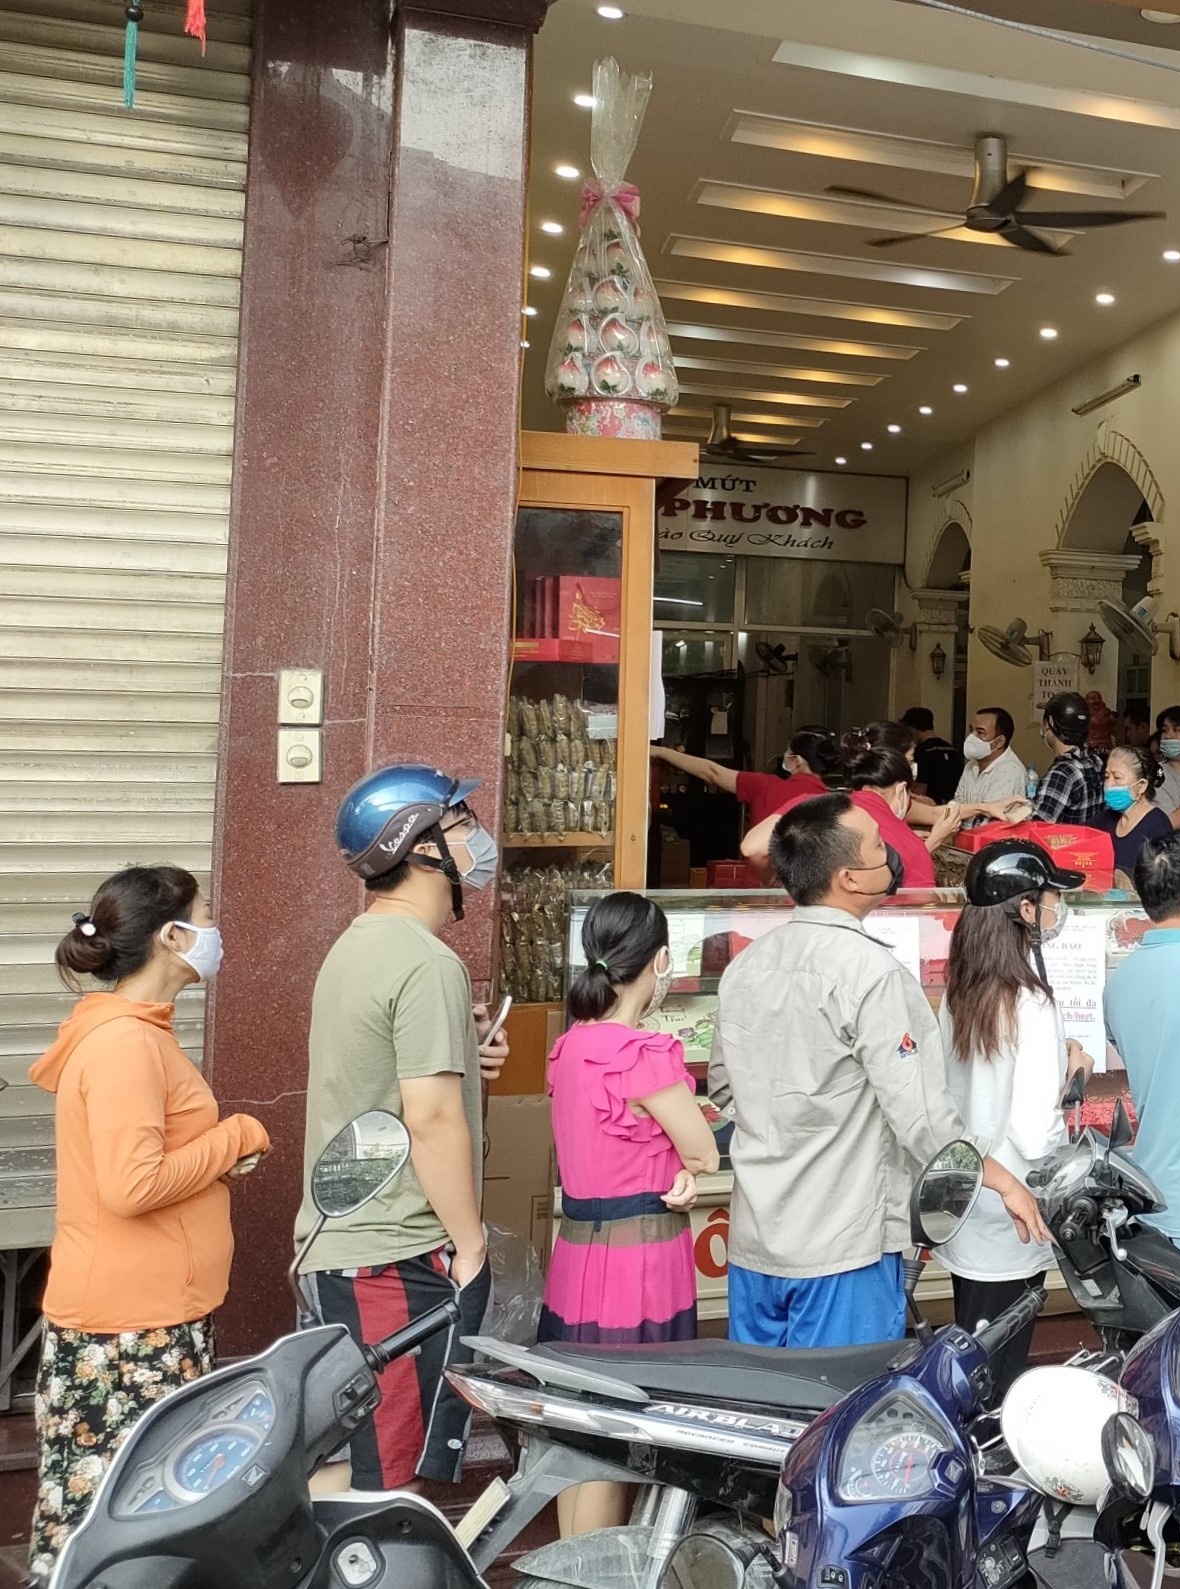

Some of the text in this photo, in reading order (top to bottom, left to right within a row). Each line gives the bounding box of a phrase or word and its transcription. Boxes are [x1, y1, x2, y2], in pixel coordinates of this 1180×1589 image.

[692, 474, 756, 493] MỨT
[661, 498, 867, 529] PHƯƠNG
[747, 532, 835, 550] Khách
[379, 812, 420, 857] Vespa
[642, 1404, 808, 1439] AIRBLAD
